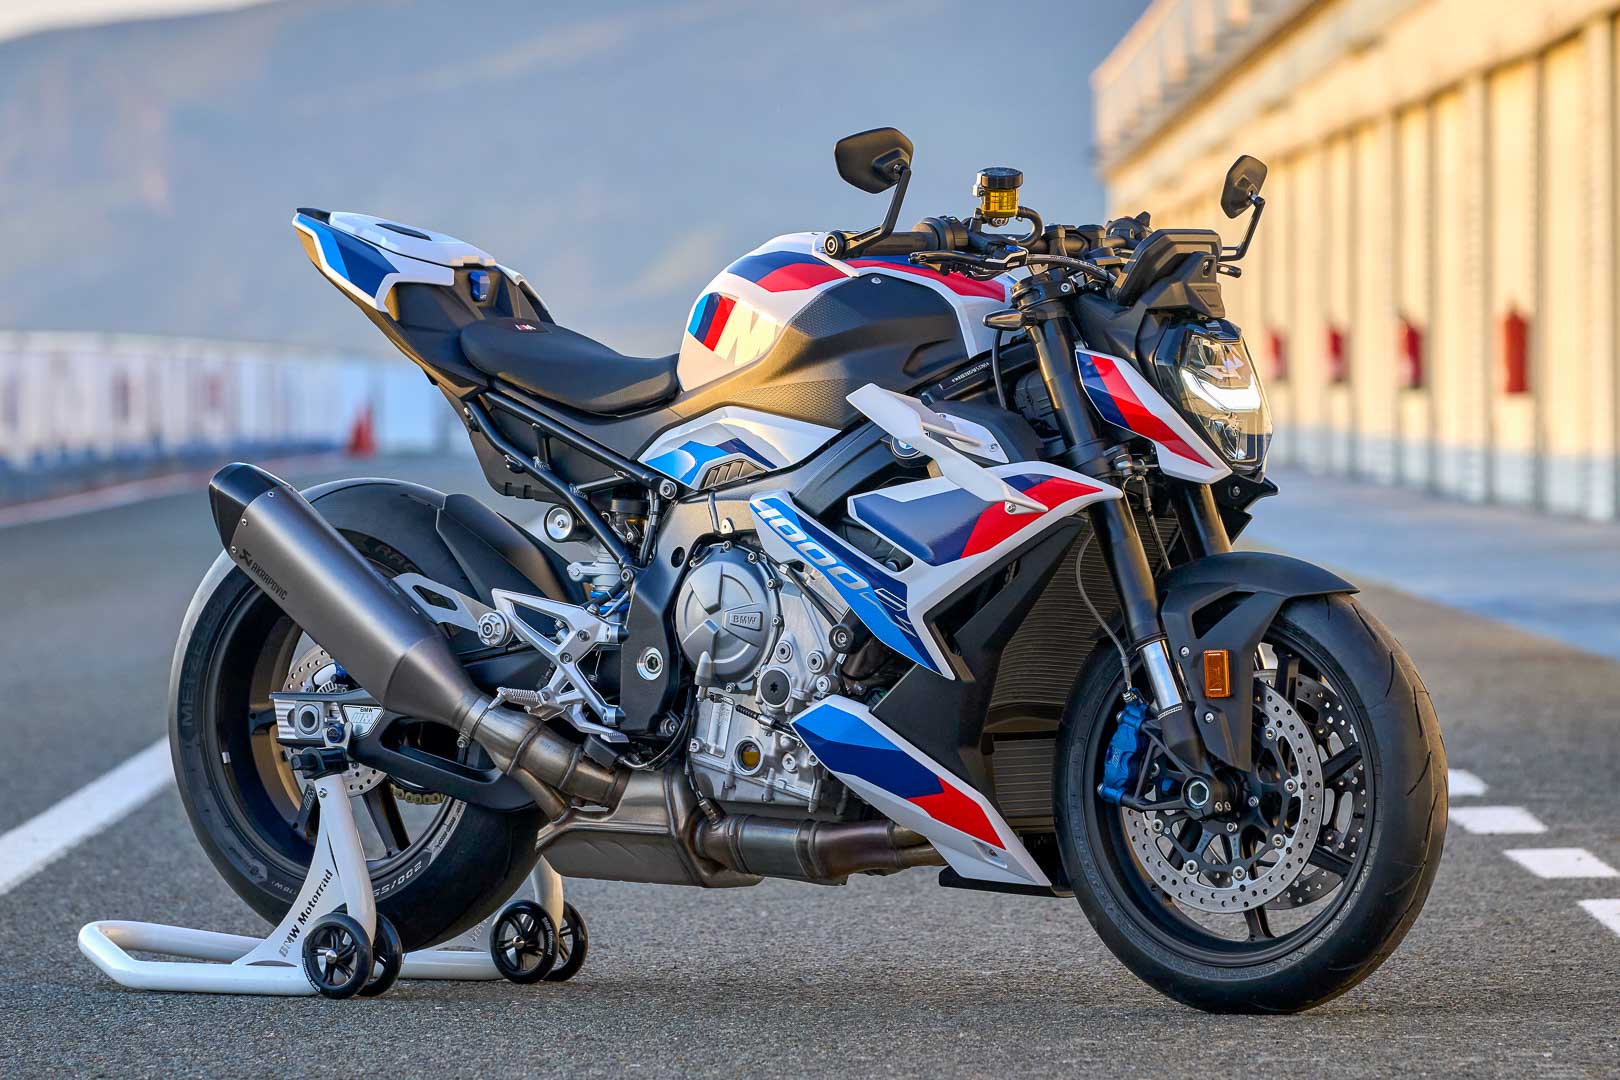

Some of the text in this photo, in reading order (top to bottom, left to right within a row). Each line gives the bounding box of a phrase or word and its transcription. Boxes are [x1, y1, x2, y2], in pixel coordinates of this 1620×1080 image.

[733, 615, 757, 625] BMW
[279, 868, 333, 957] BMW Motorrad
